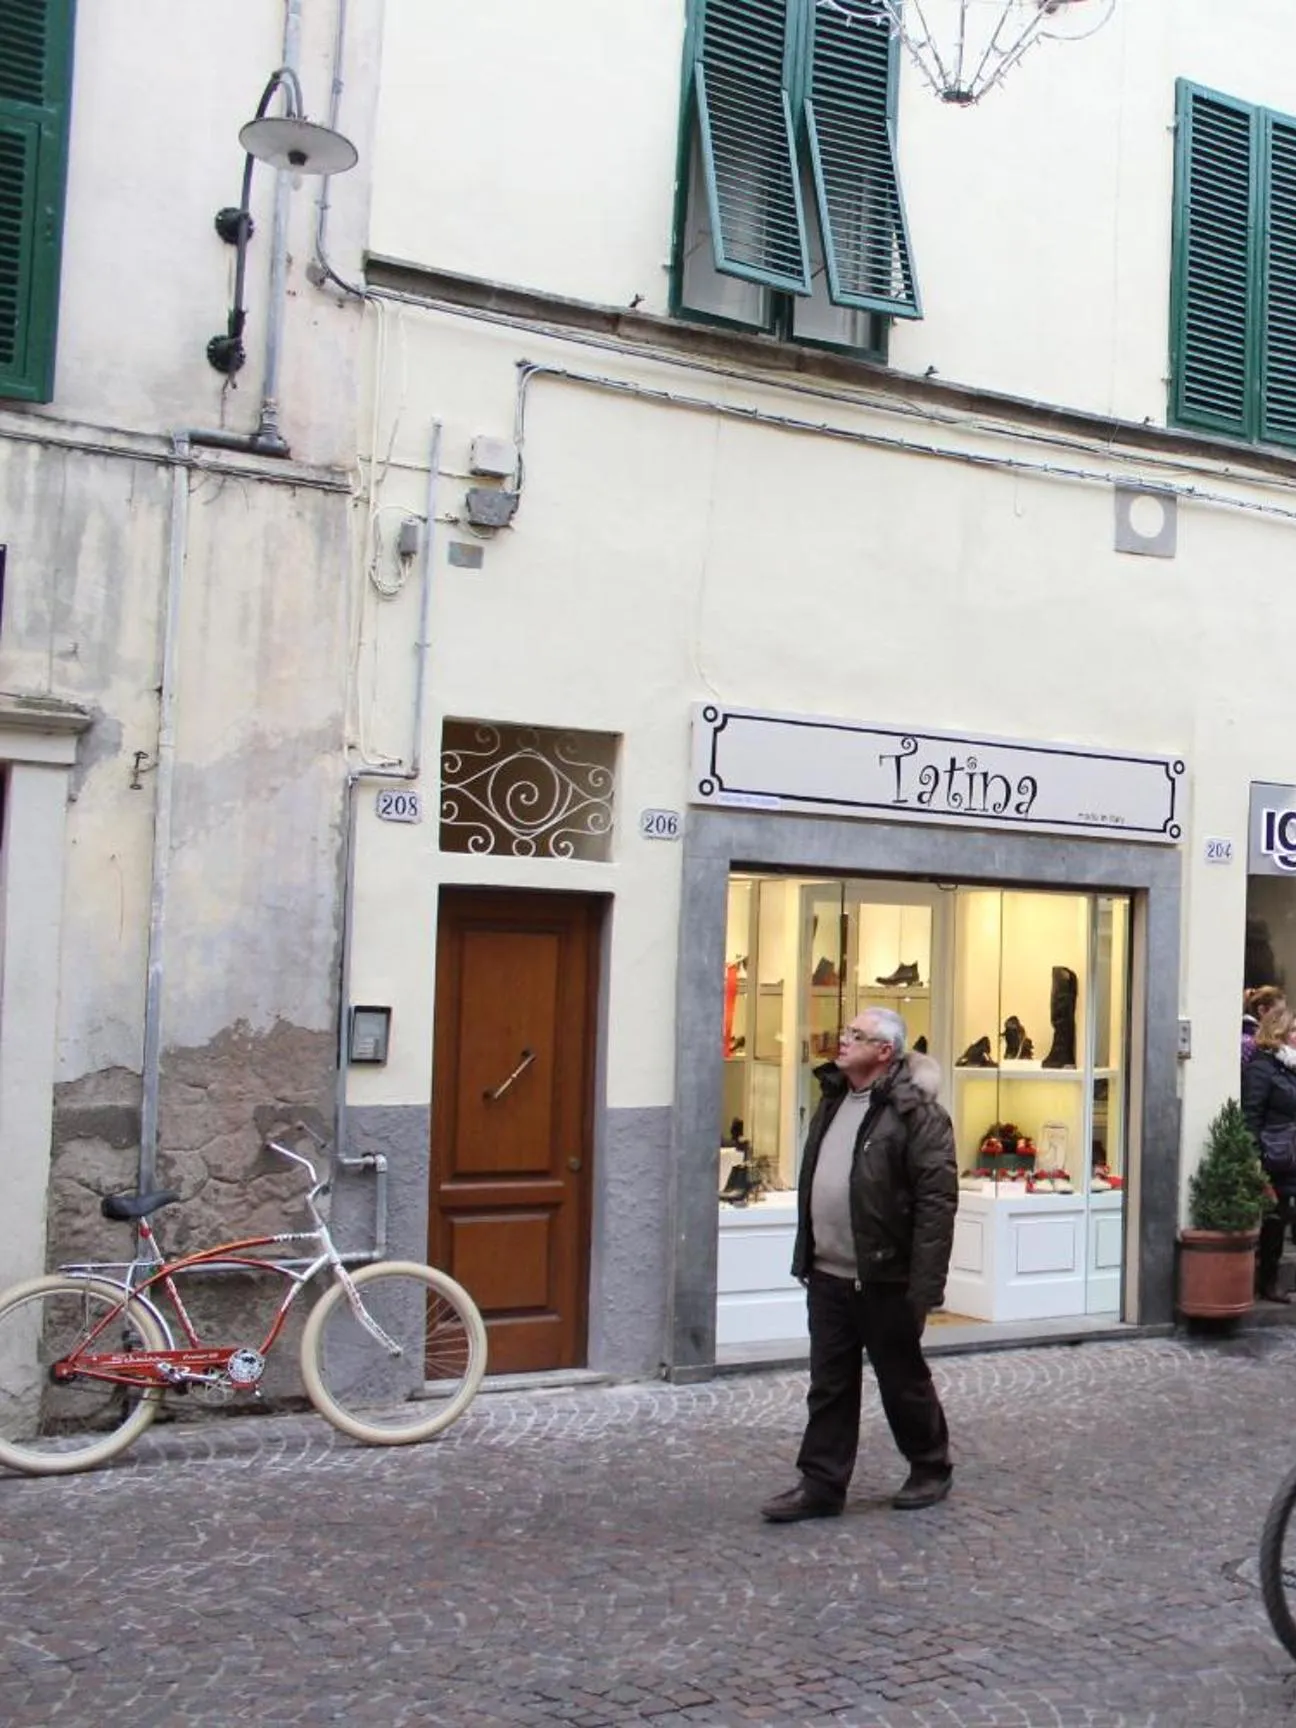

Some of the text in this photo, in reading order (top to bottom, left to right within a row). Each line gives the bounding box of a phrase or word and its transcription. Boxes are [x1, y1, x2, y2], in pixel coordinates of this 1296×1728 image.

[879, 736, 1038, 818] Tatina
[381, 794, 418, 817] 208
[644, 814, 677, 834] 206
[1207, 841, 1231, 859] 204
